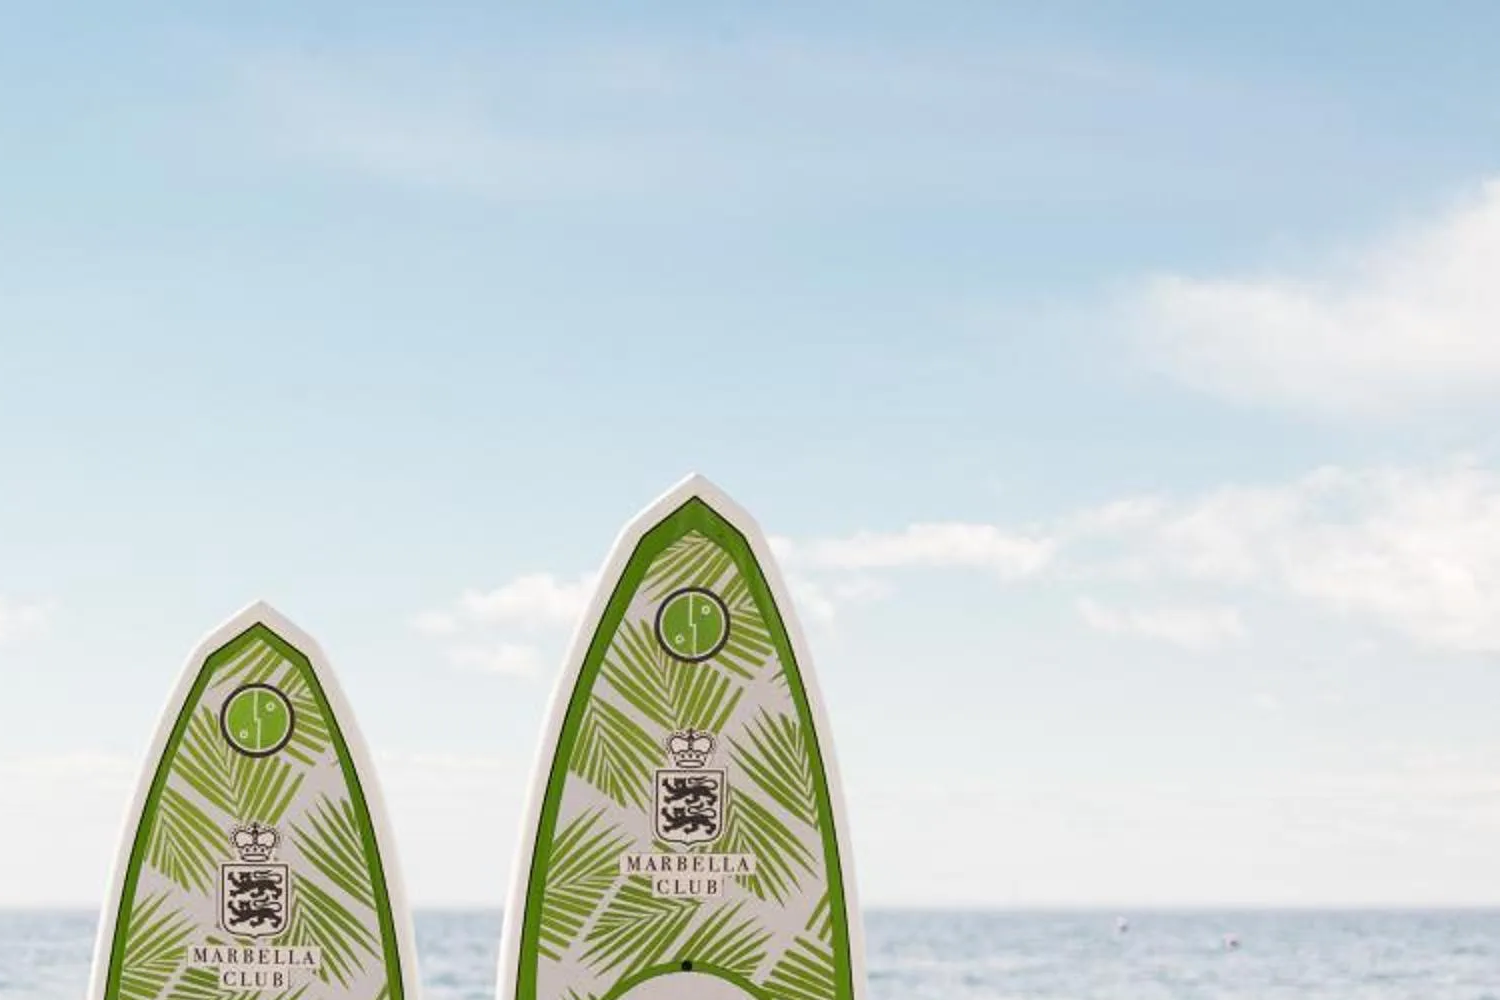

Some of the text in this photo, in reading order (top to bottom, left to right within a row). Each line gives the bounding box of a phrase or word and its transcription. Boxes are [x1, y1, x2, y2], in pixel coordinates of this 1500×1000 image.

[627, 855, 749, 873] MARBELLA
[656, 879, 718, 895] CLUB
[193, 947, 315, 965] MARBELLA
[223, 971, 284, 987] CLUB
